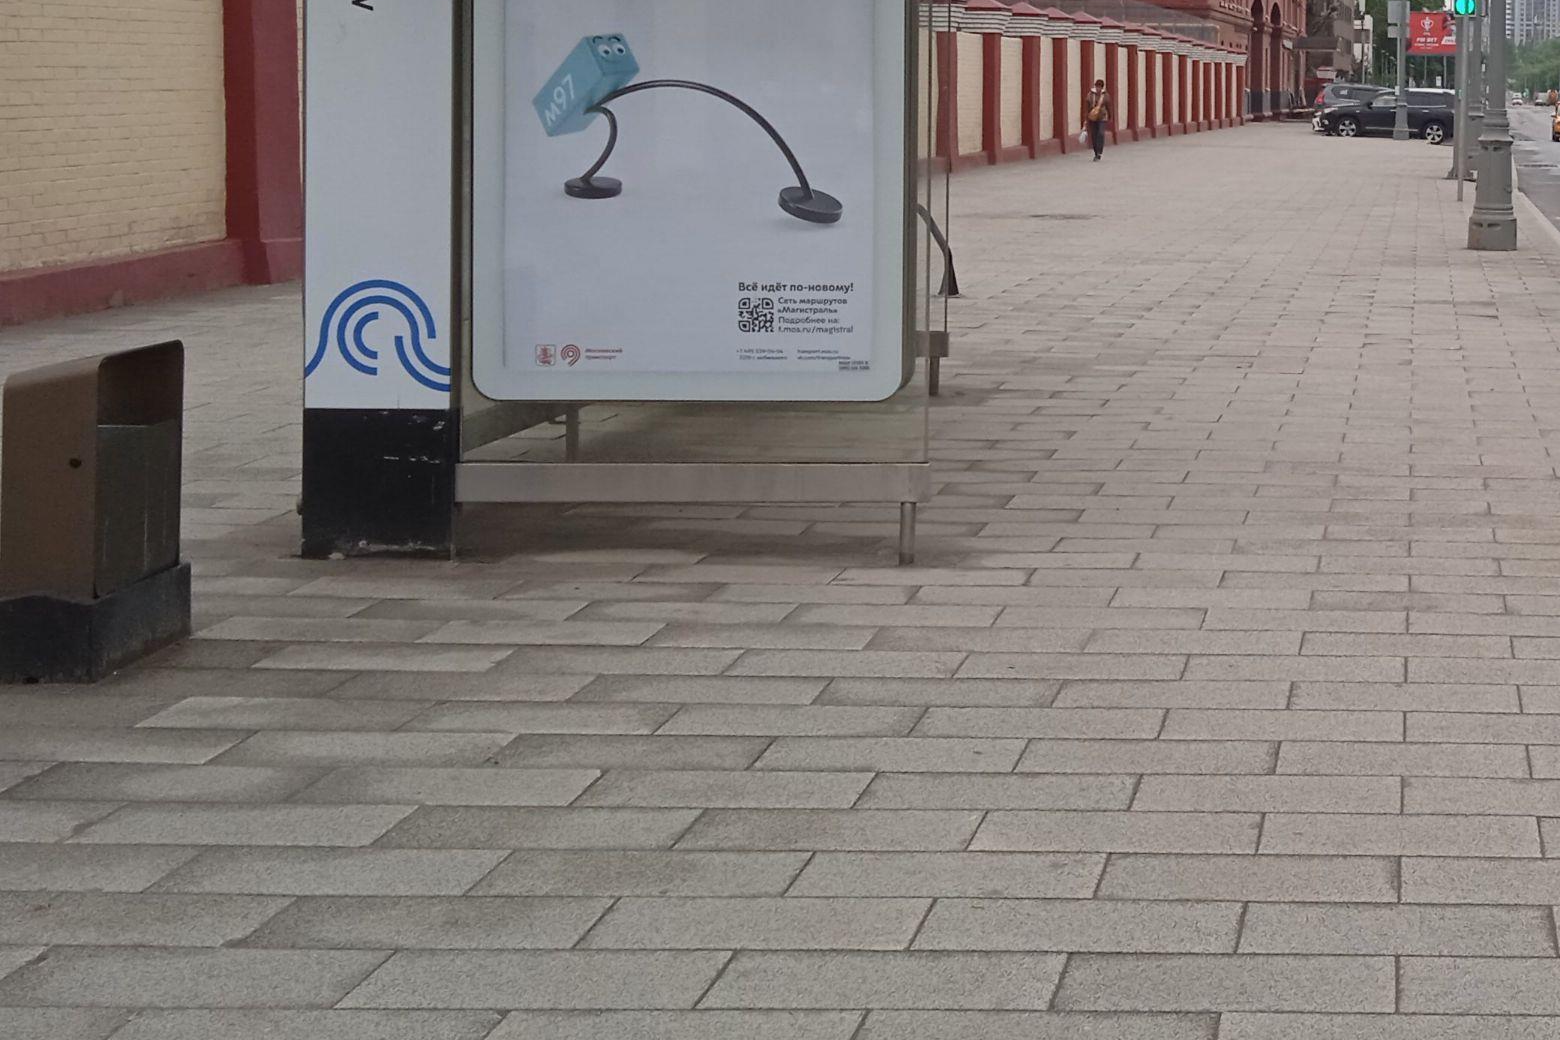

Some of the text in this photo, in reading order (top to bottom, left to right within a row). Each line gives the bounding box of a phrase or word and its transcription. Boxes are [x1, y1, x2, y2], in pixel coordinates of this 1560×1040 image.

[738, 281, 854, 295] Всё идёт по-новому!
[778, 296, 848, 306] Сеть маршрутов
[778, 316, 826, 325] Подробнее
